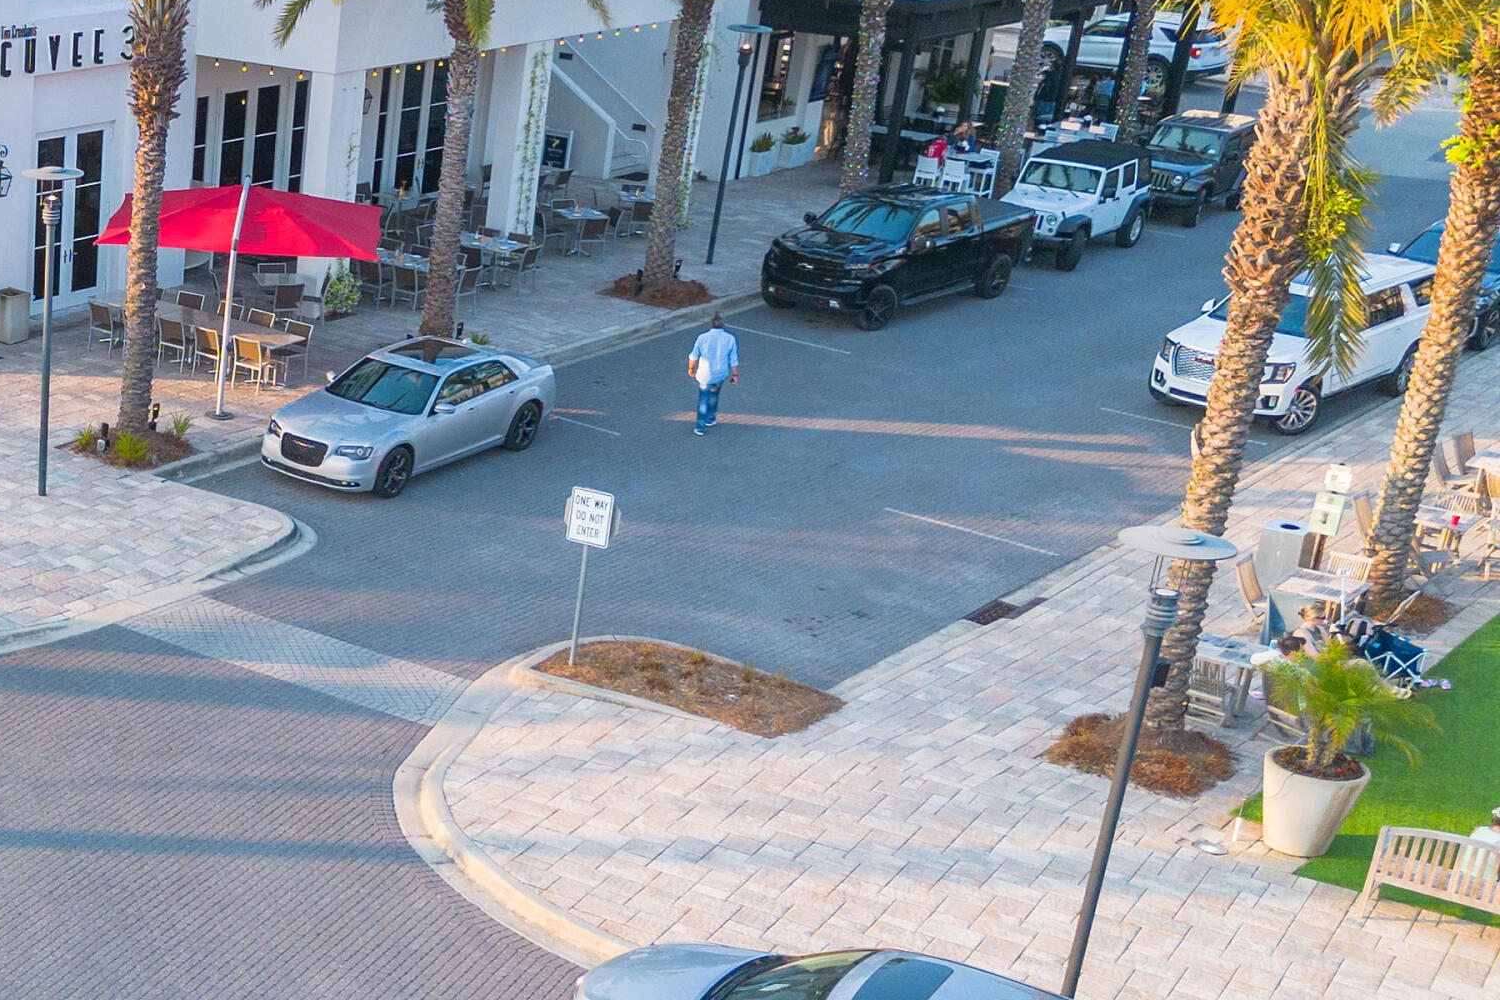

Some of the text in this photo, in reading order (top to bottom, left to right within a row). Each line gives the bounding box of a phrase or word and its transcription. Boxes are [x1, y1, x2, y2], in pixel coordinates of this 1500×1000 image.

[0, 28, 105, 78] CUVEE
[575, 495, 608, 511] ONE WAY
[576, 510, 604, 525] DO NOT
[576, 524, 600, 539] ENTER
